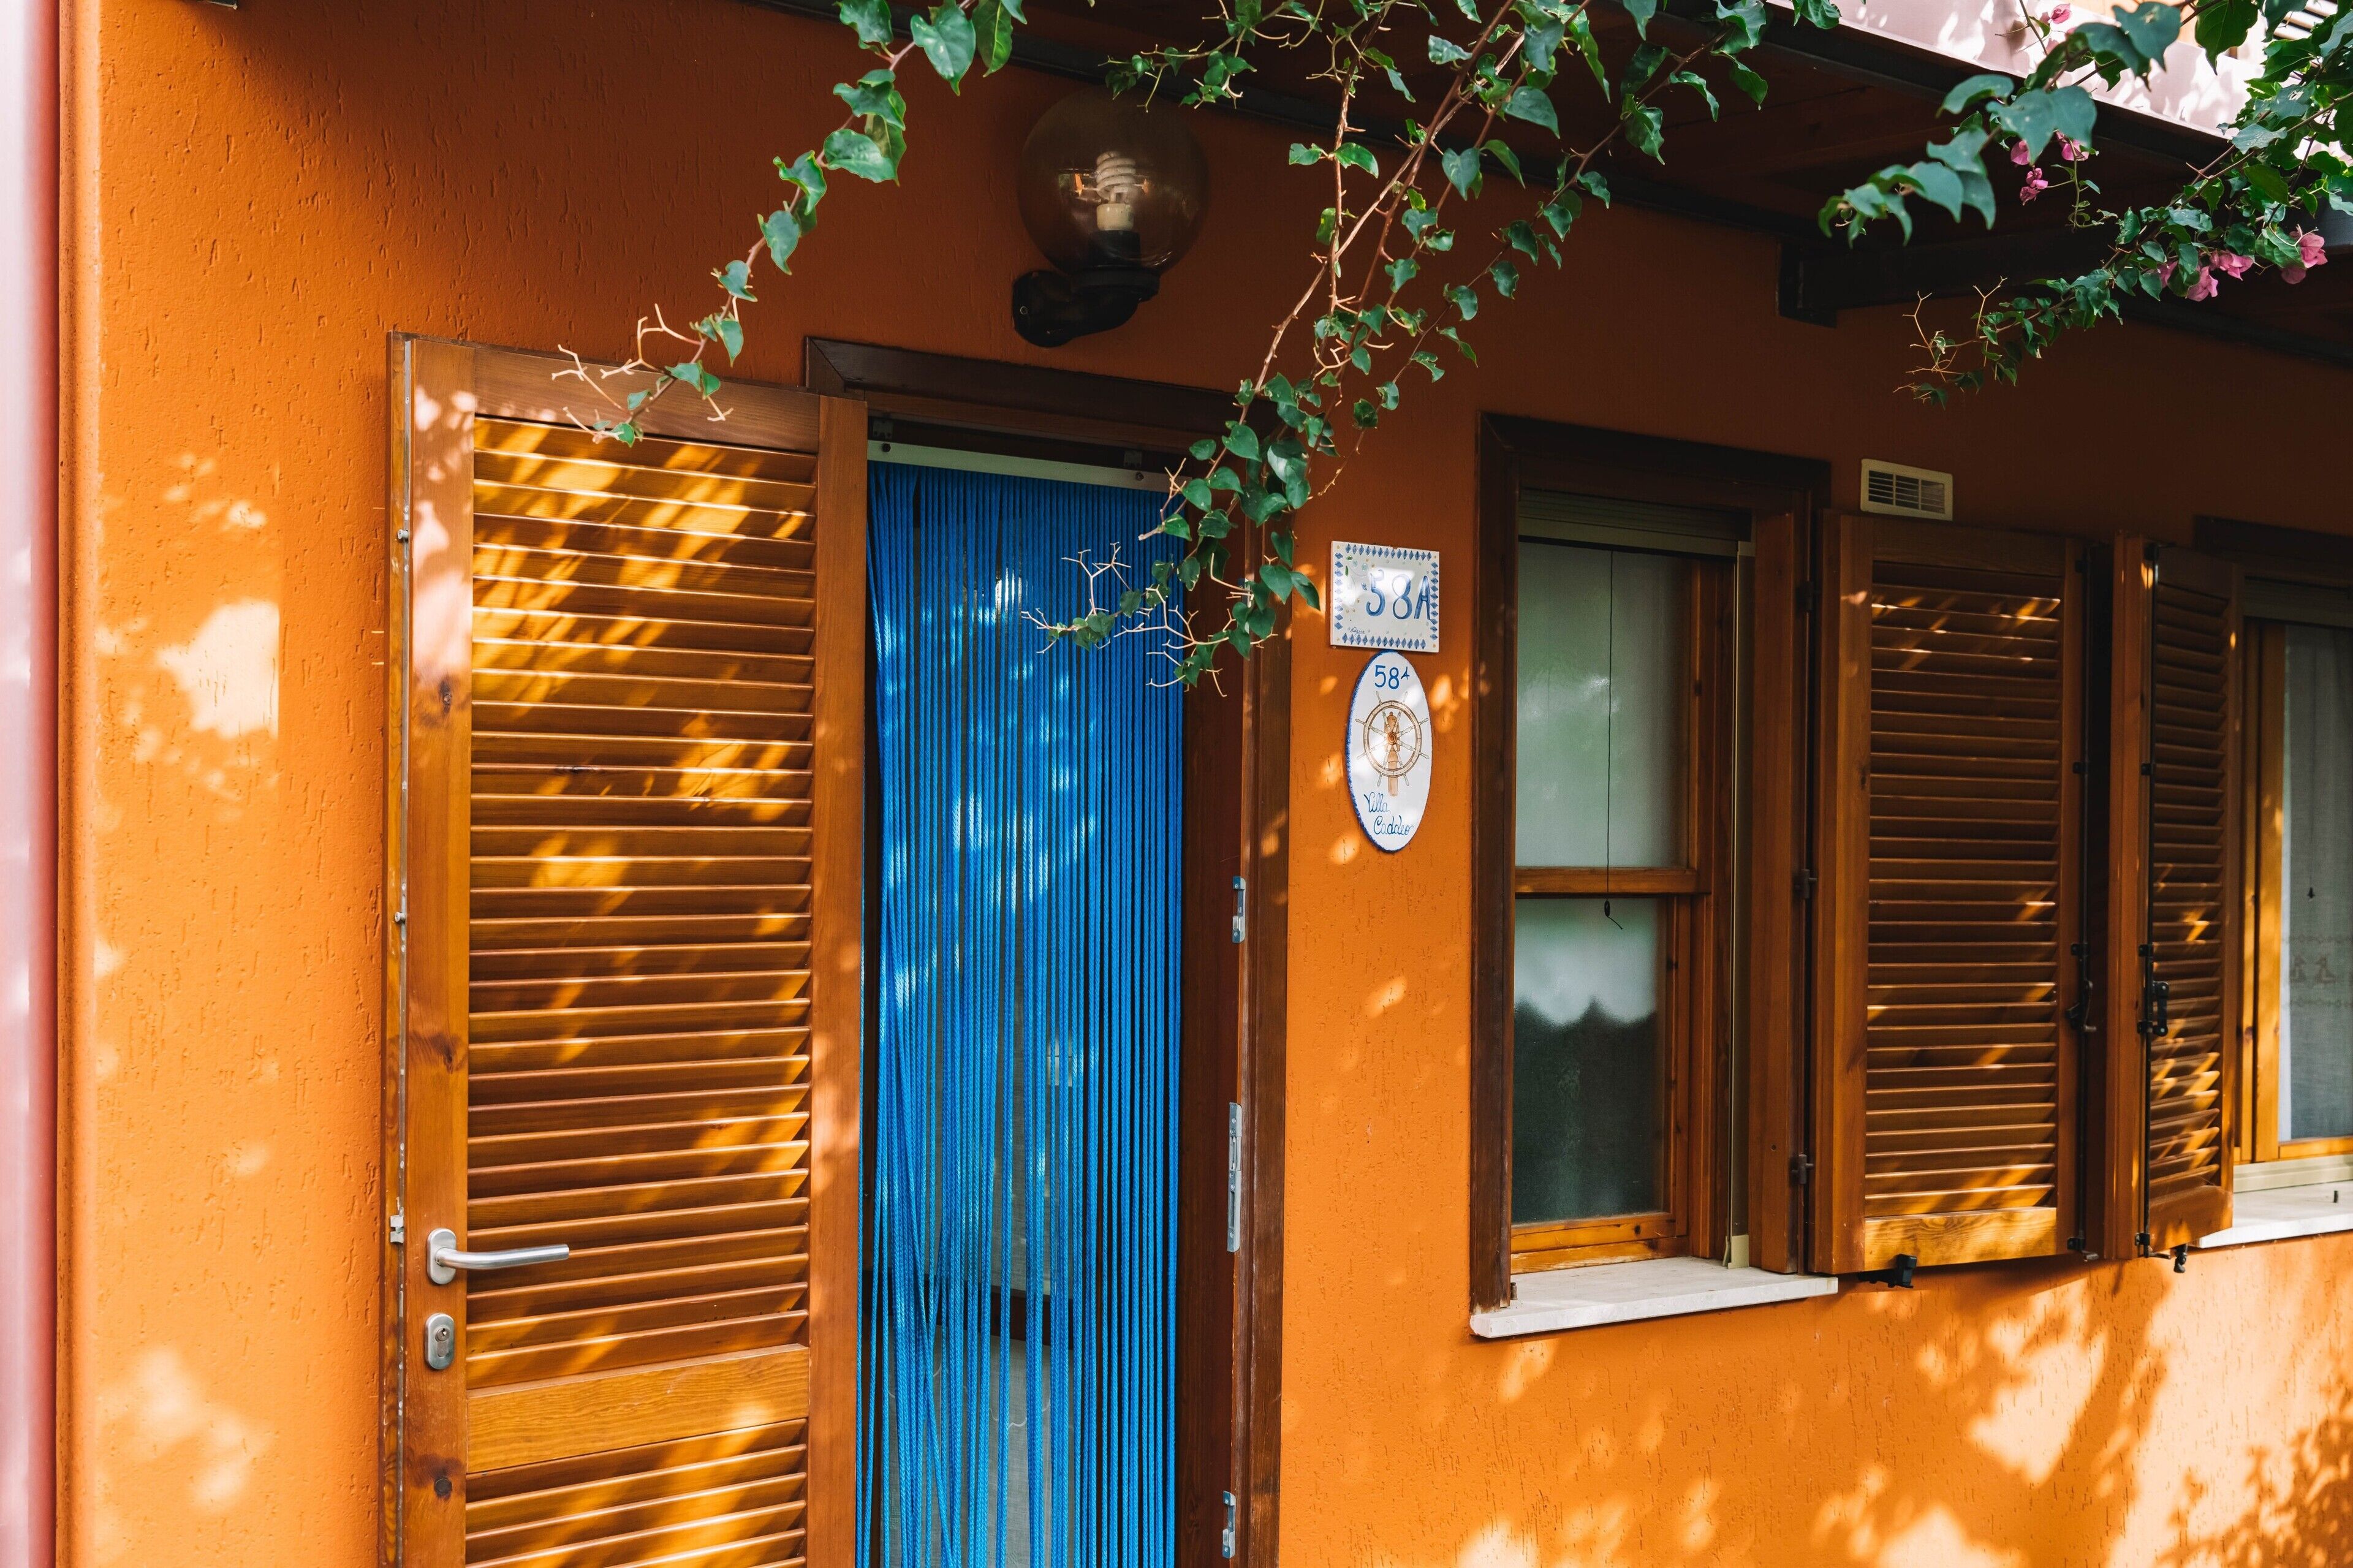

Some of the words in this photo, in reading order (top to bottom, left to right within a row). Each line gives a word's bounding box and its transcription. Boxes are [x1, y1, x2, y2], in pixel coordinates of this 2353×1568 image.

[1366, 569, 1431, 619] 58A
[1374, 665, 1410, 689] 58A
[1363, 792, 1390, 813] Villa
